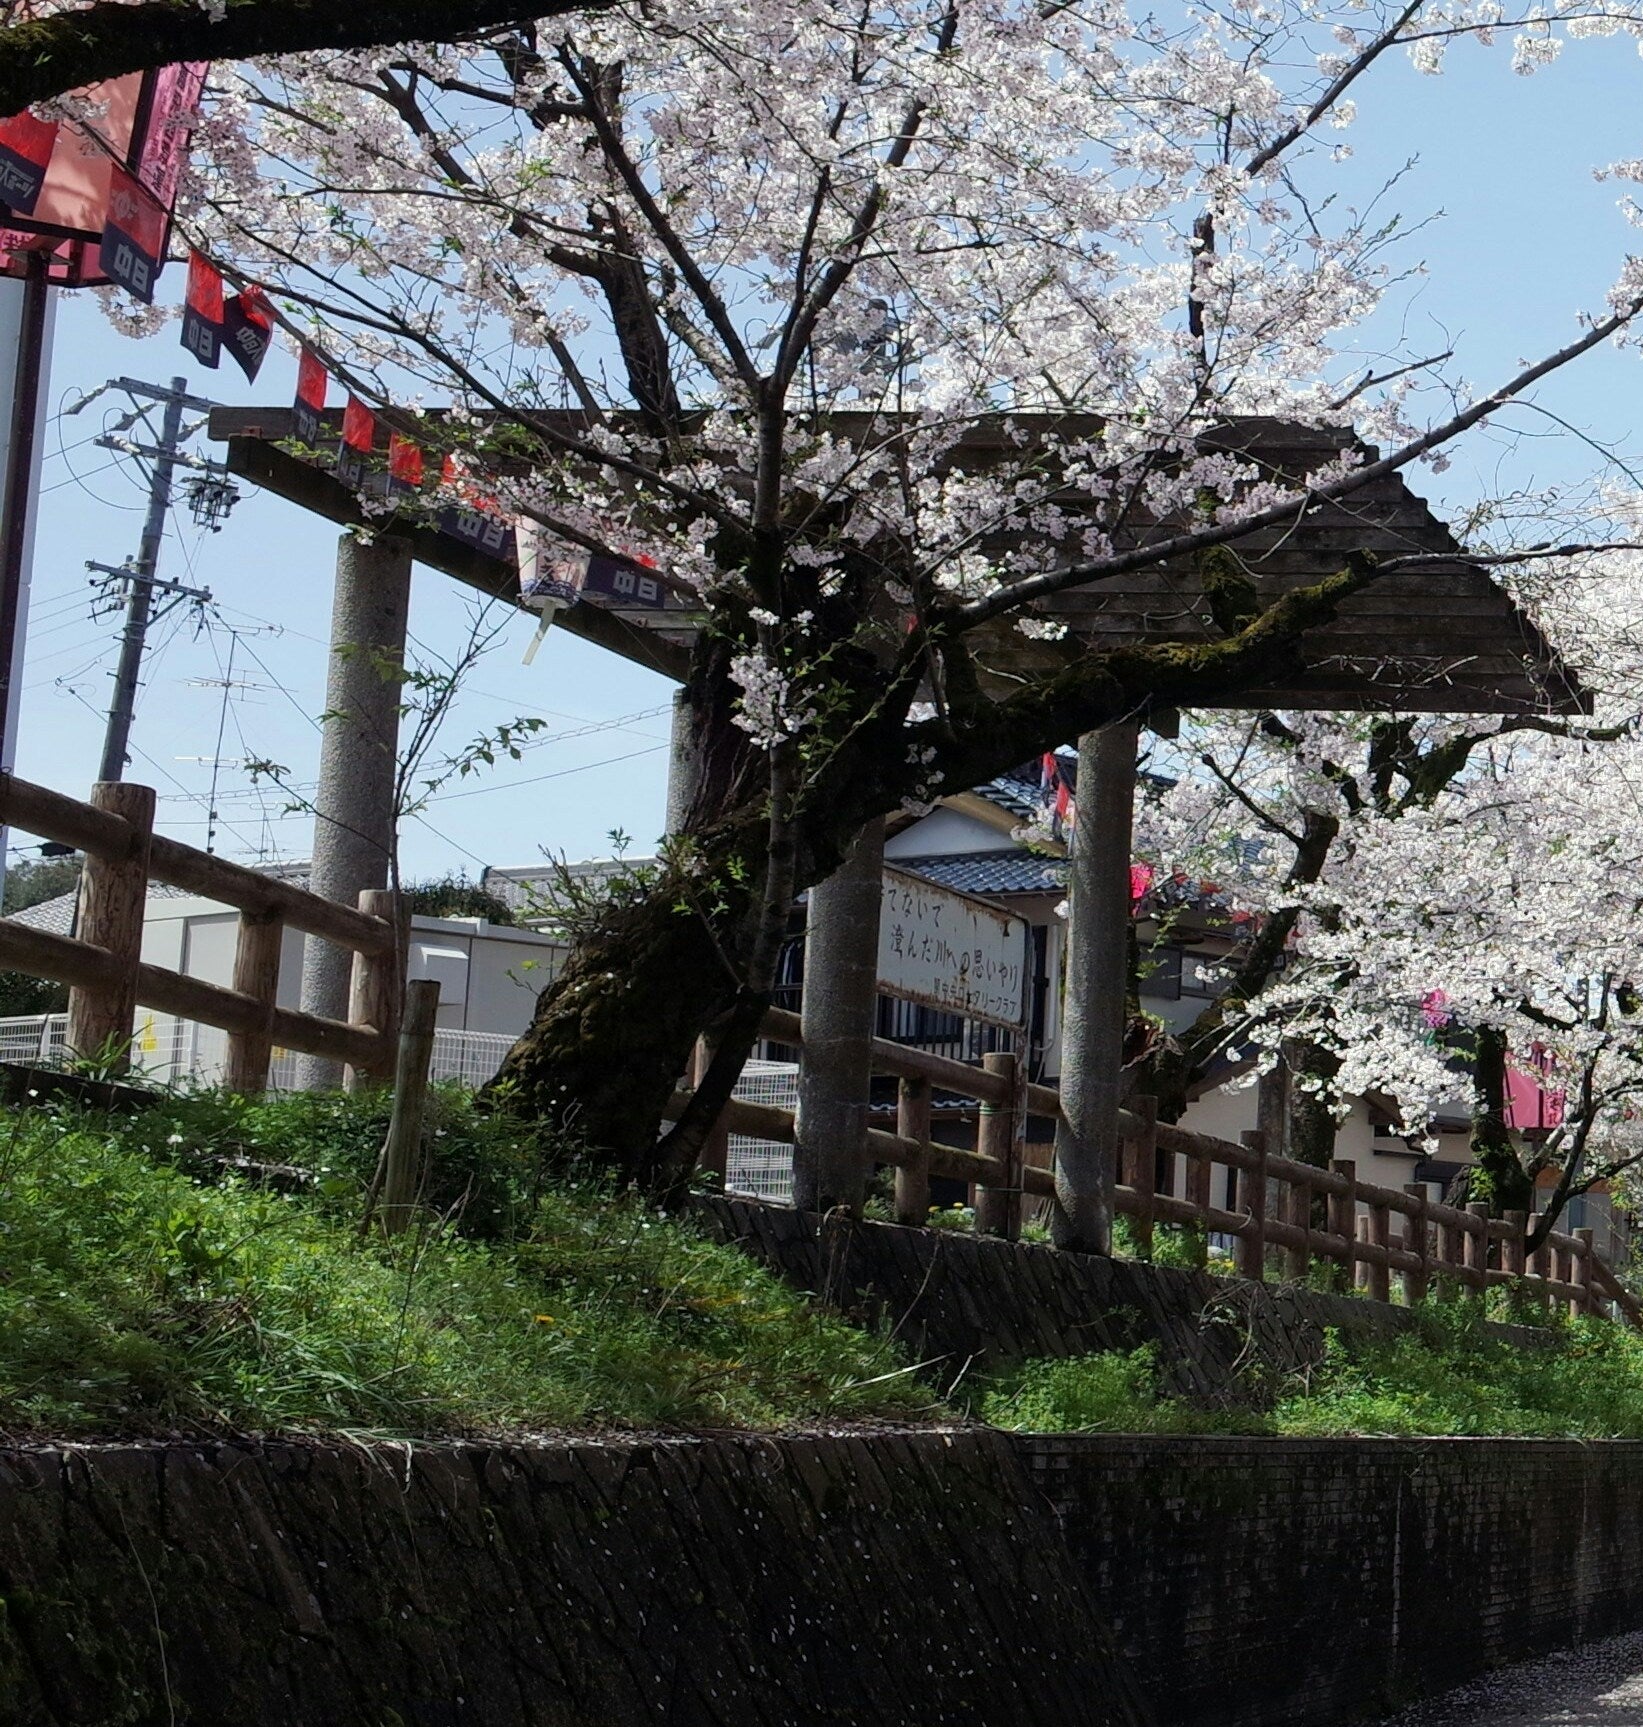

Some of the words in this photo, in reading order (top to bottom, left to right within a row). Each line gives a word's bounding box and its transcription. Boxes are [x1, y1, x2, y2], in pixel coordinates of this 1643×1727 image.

[113, 243, 149, 294] 中日
[188, 318, 213, 359] 中日
[613, 570, 658, 601] 中日
[881, 886, 944, 928] てないで
